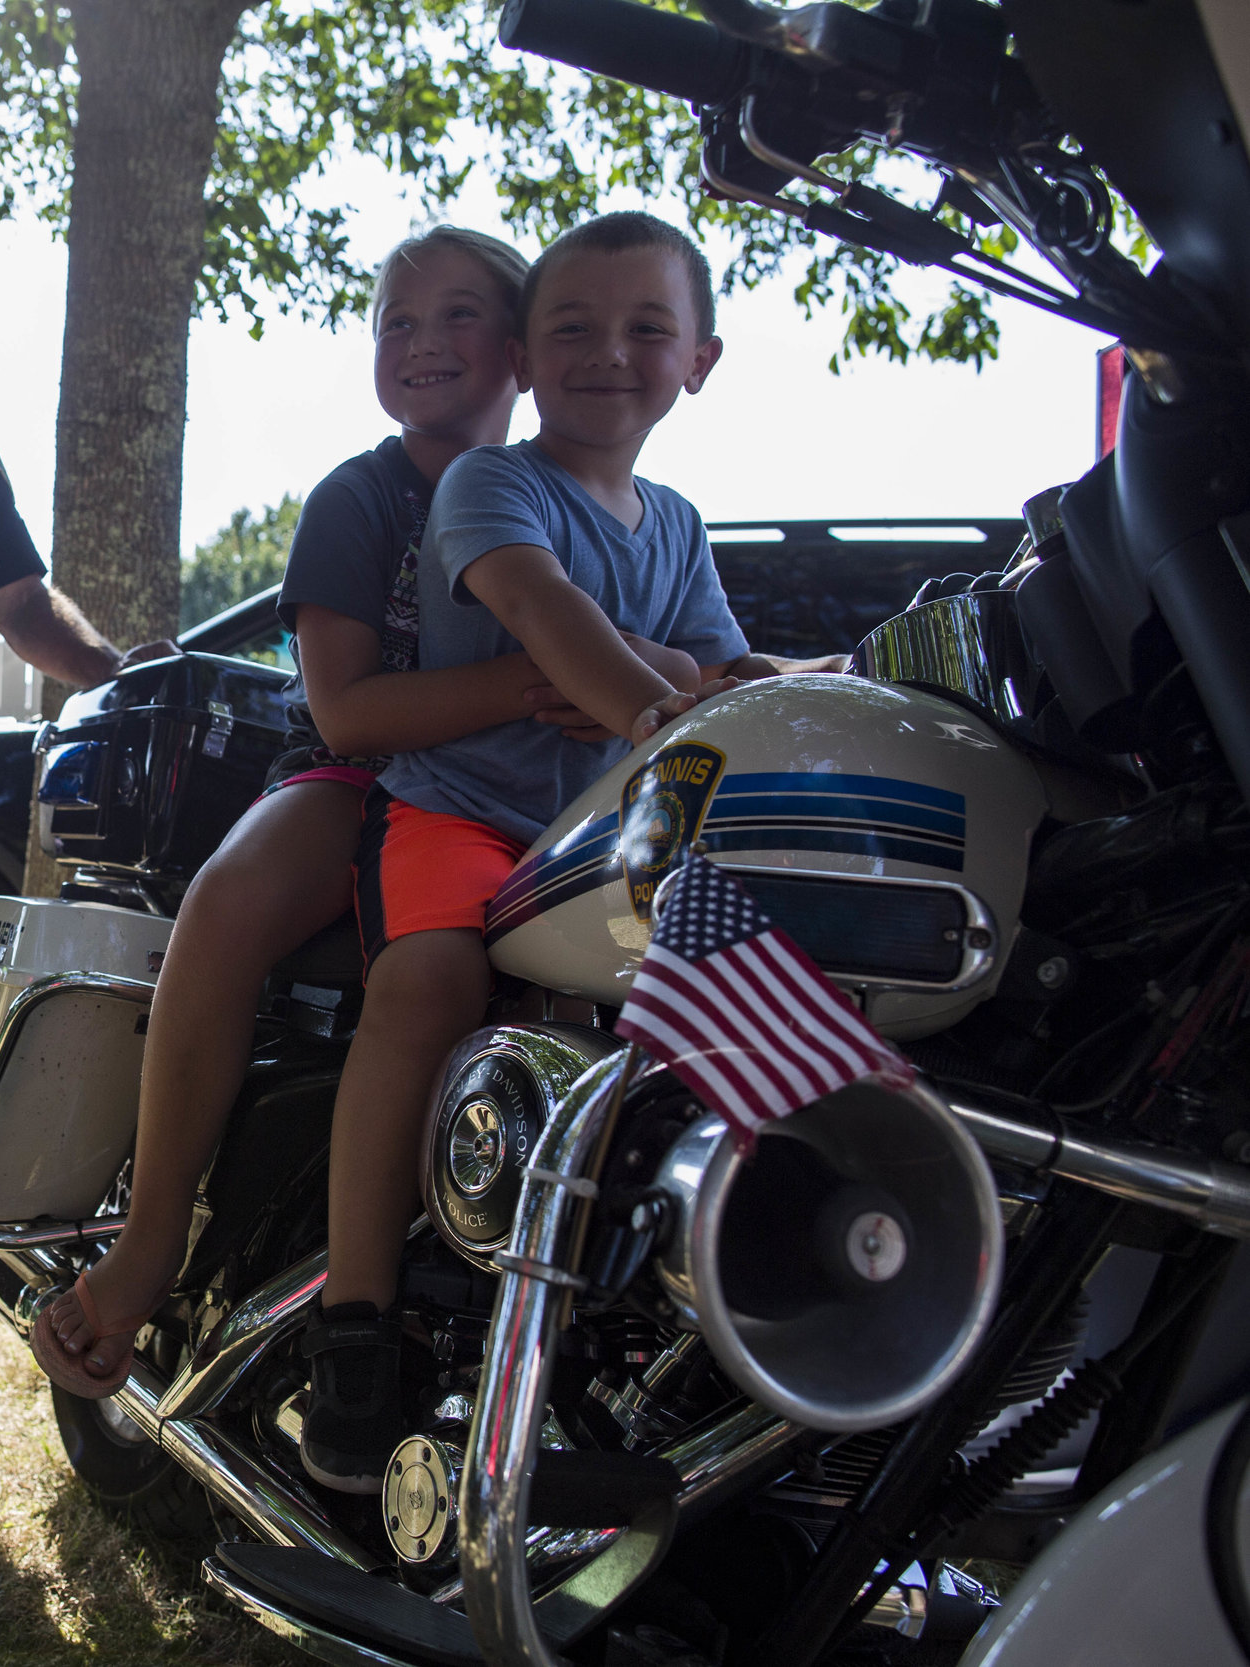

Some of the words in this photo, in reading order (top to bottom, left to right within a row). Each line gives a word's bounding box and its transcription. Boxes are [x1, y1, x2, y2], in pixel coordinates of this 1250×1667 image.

[629, 756, 714, 804] DENNIS
[633, 879, 660, 904] POL
[442, 1192, 487, 1228] POLICE
